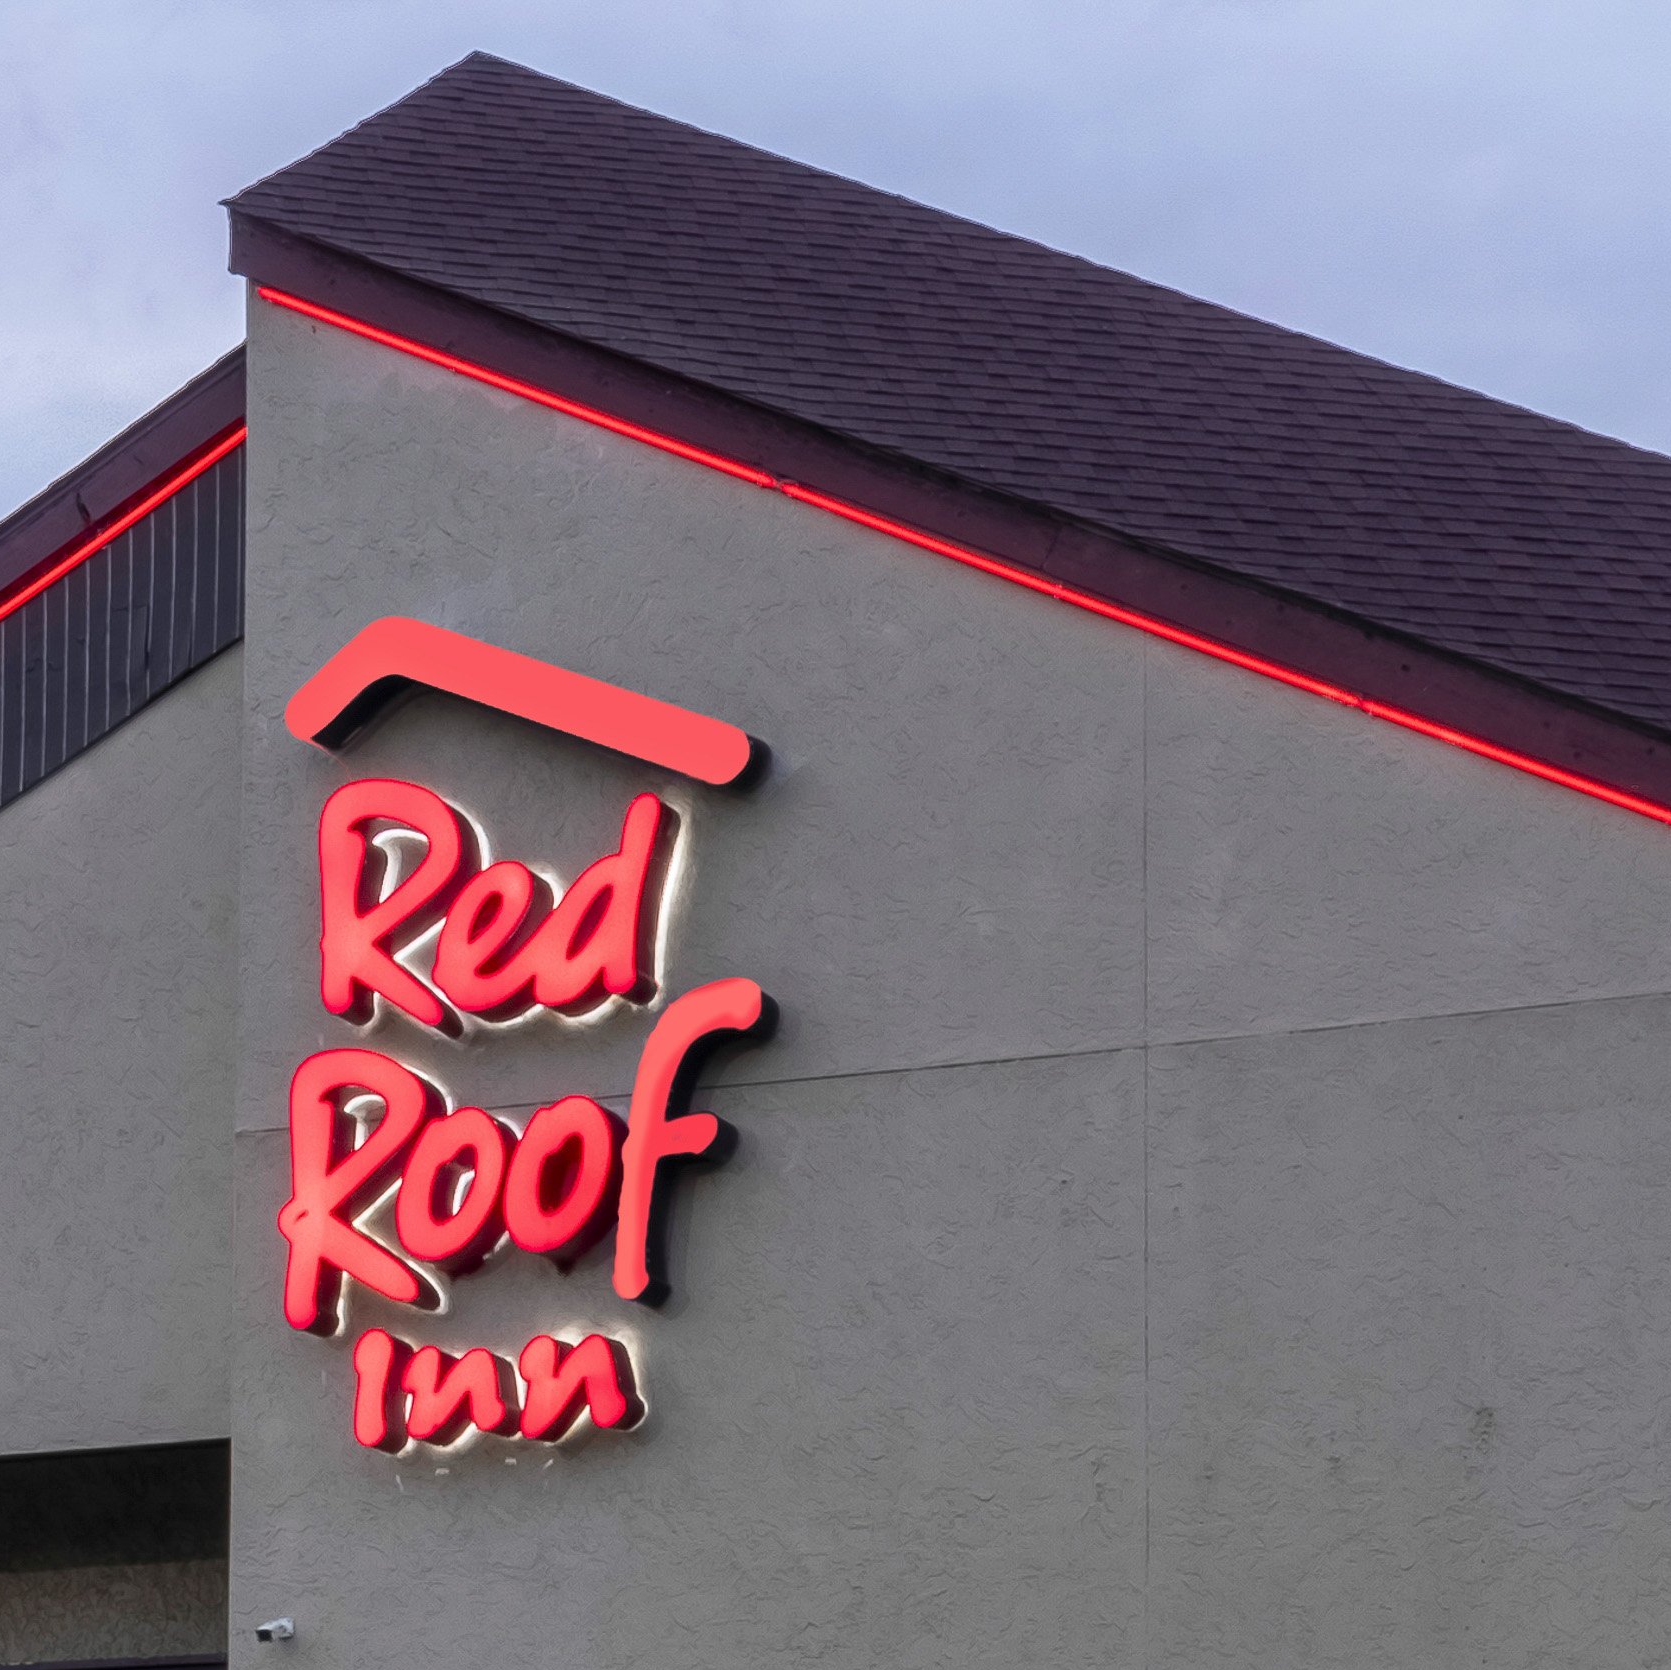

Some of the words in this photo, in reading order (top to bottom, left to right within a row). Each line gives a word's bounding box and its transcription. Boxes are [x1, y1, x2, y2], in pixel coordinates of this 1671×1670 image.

[320, 779, 662, 1026] Red
[278, 977, 762, 1331] Roof
[353, 1328, 628, 1448] Inn
